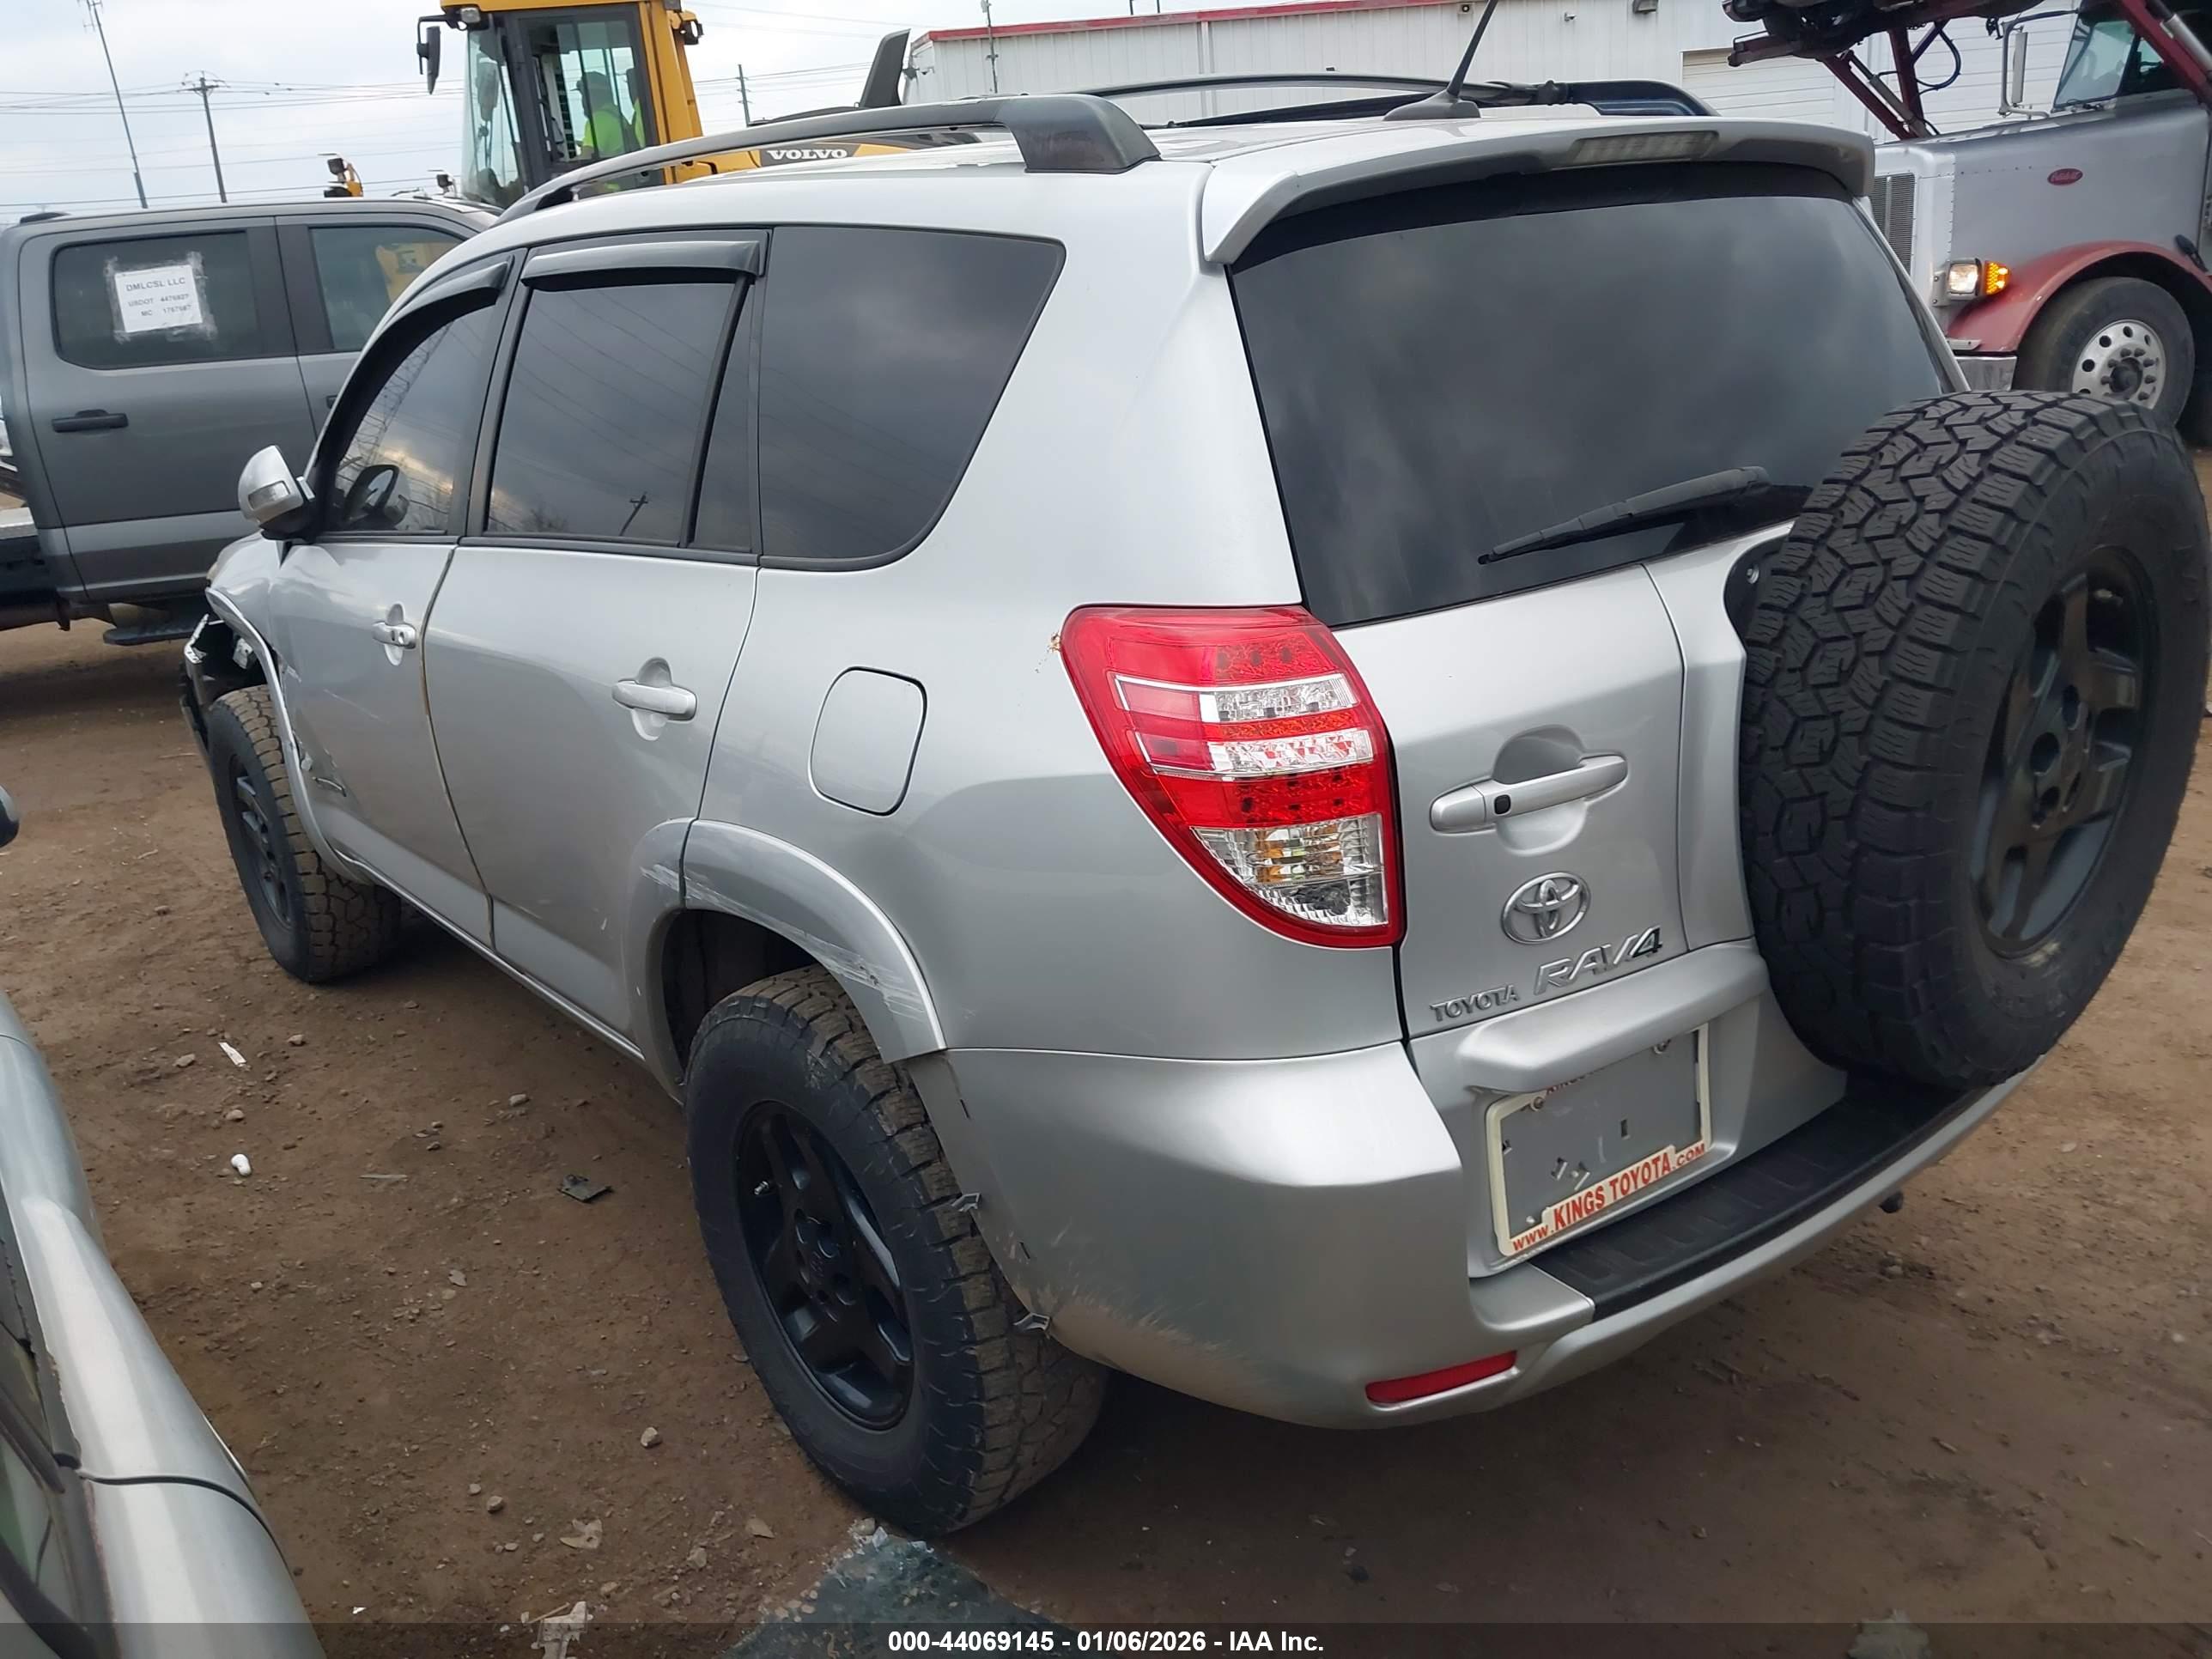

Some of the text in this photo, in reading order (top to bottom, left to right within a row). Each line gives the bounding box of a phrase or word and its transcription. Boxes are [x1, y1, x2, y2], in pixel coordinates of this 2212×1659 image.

[767, 149, 848, 161] VOLVO
[126, 276, 185, 292] DMLCSL LLC
[128, 297, 154, 307] USDOT
[1430, 924, 1663, 1022] TOYOTA RAV4
